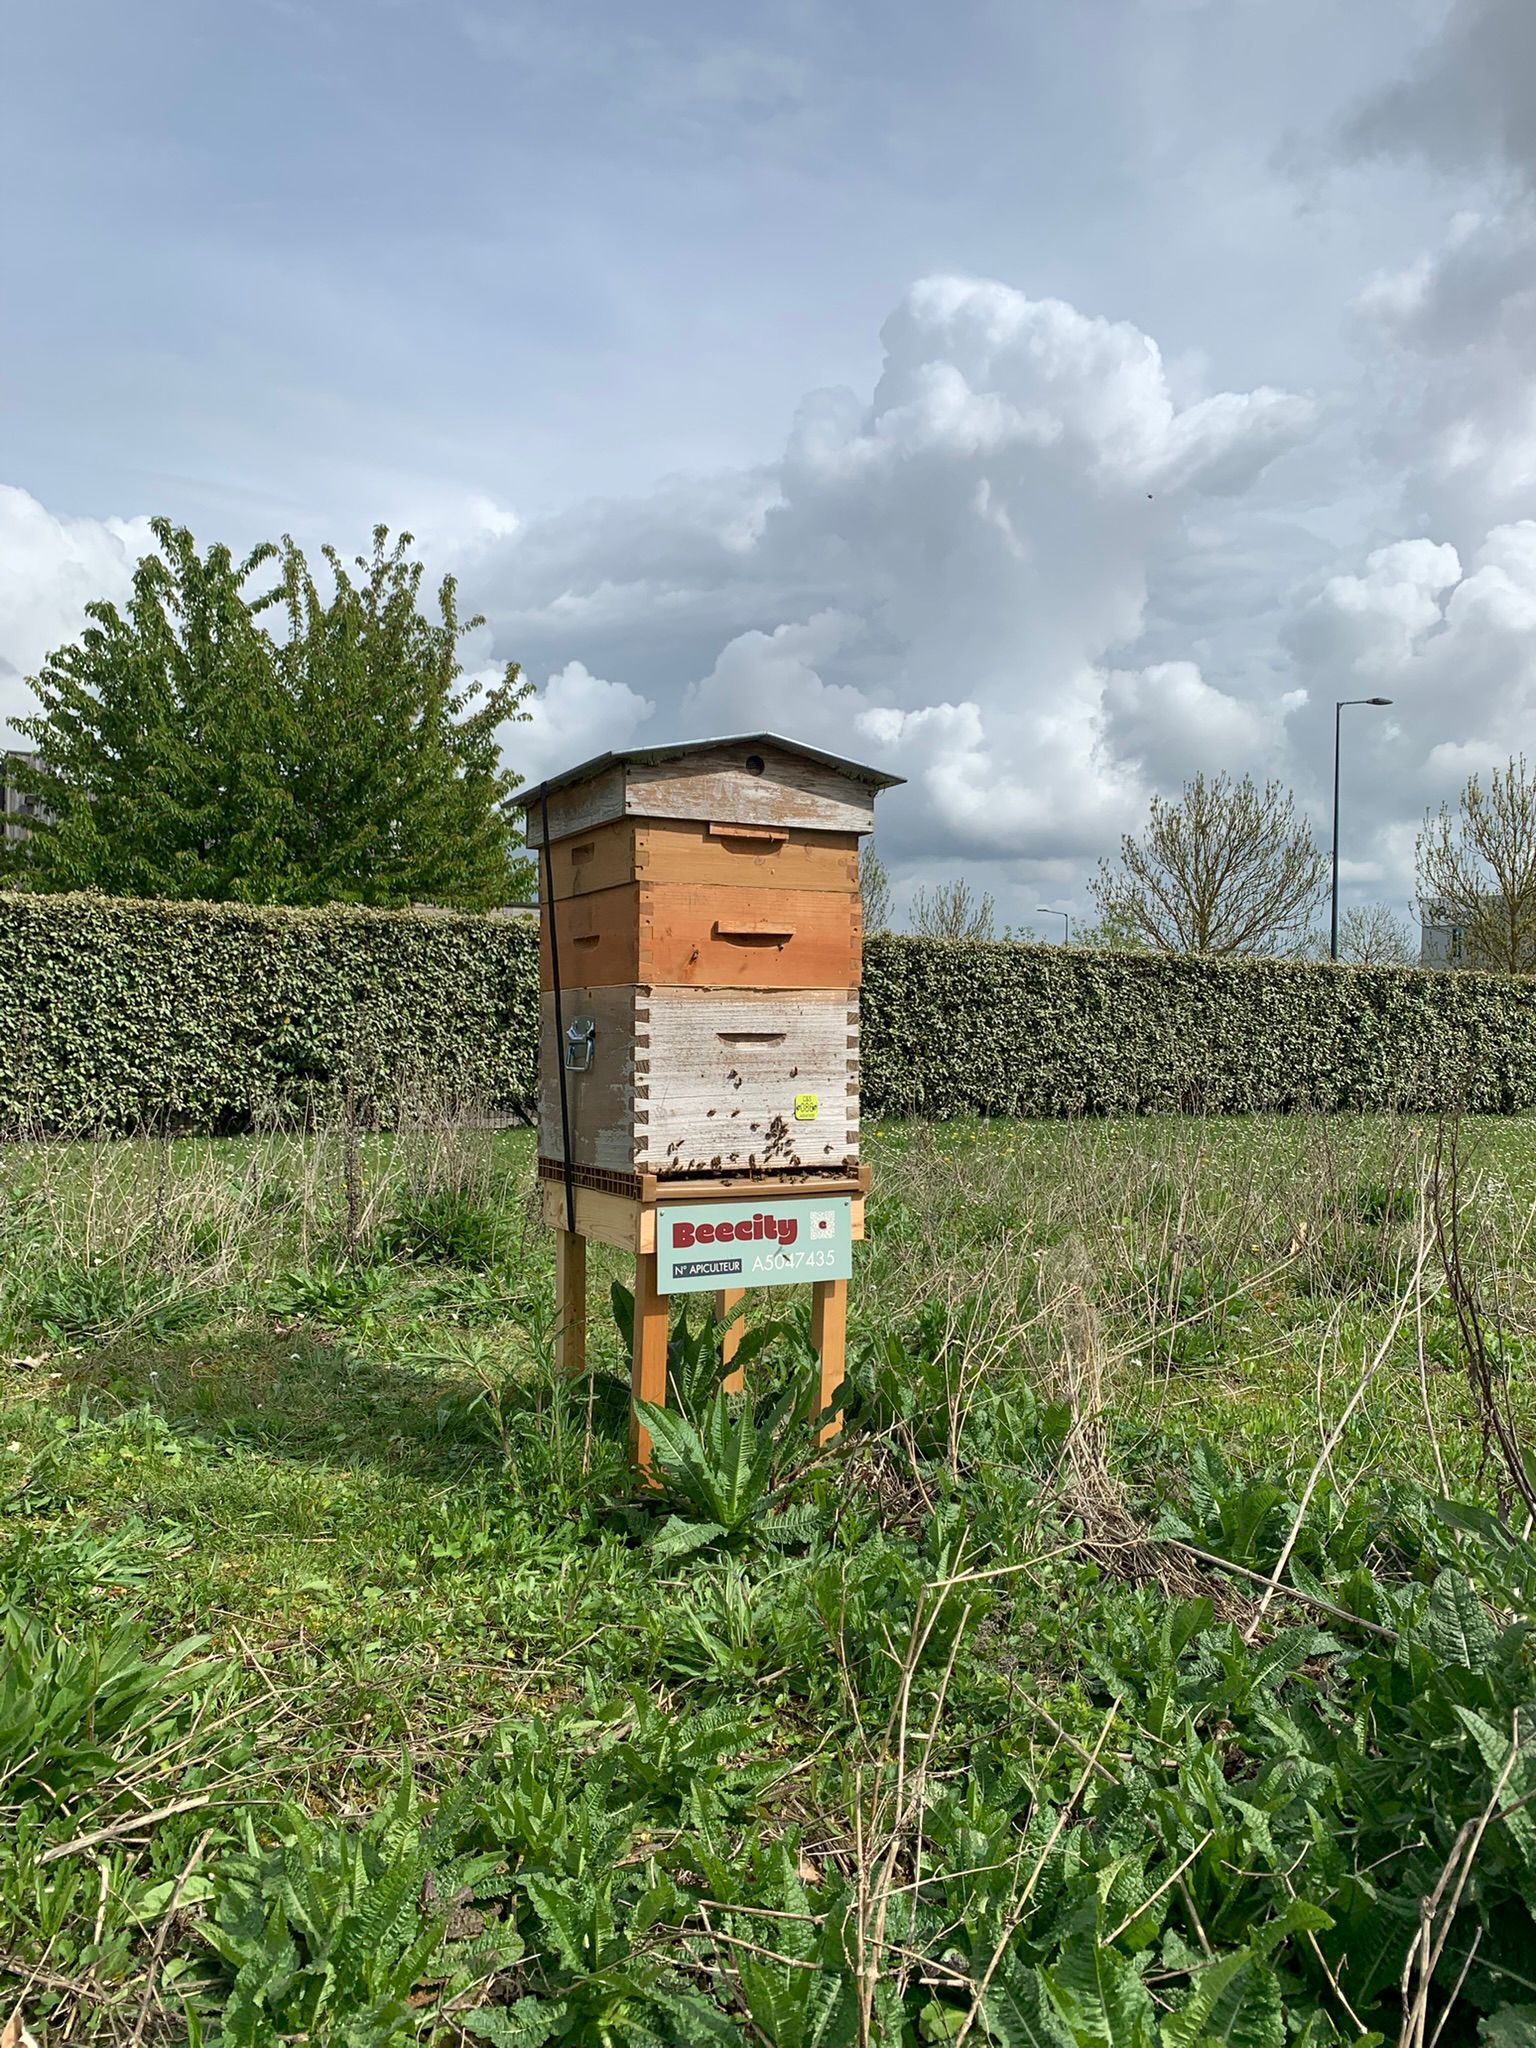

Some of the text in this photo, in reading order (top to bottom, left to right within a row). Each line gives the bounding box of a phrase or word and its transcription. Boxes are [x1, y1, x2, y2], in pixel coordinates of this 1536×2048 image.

[672, 1213, 798, 1249] Beecity
[689, 1261, 740, 1274] APICULTEUR
[752, 1250, 835, 1272] A5047435
